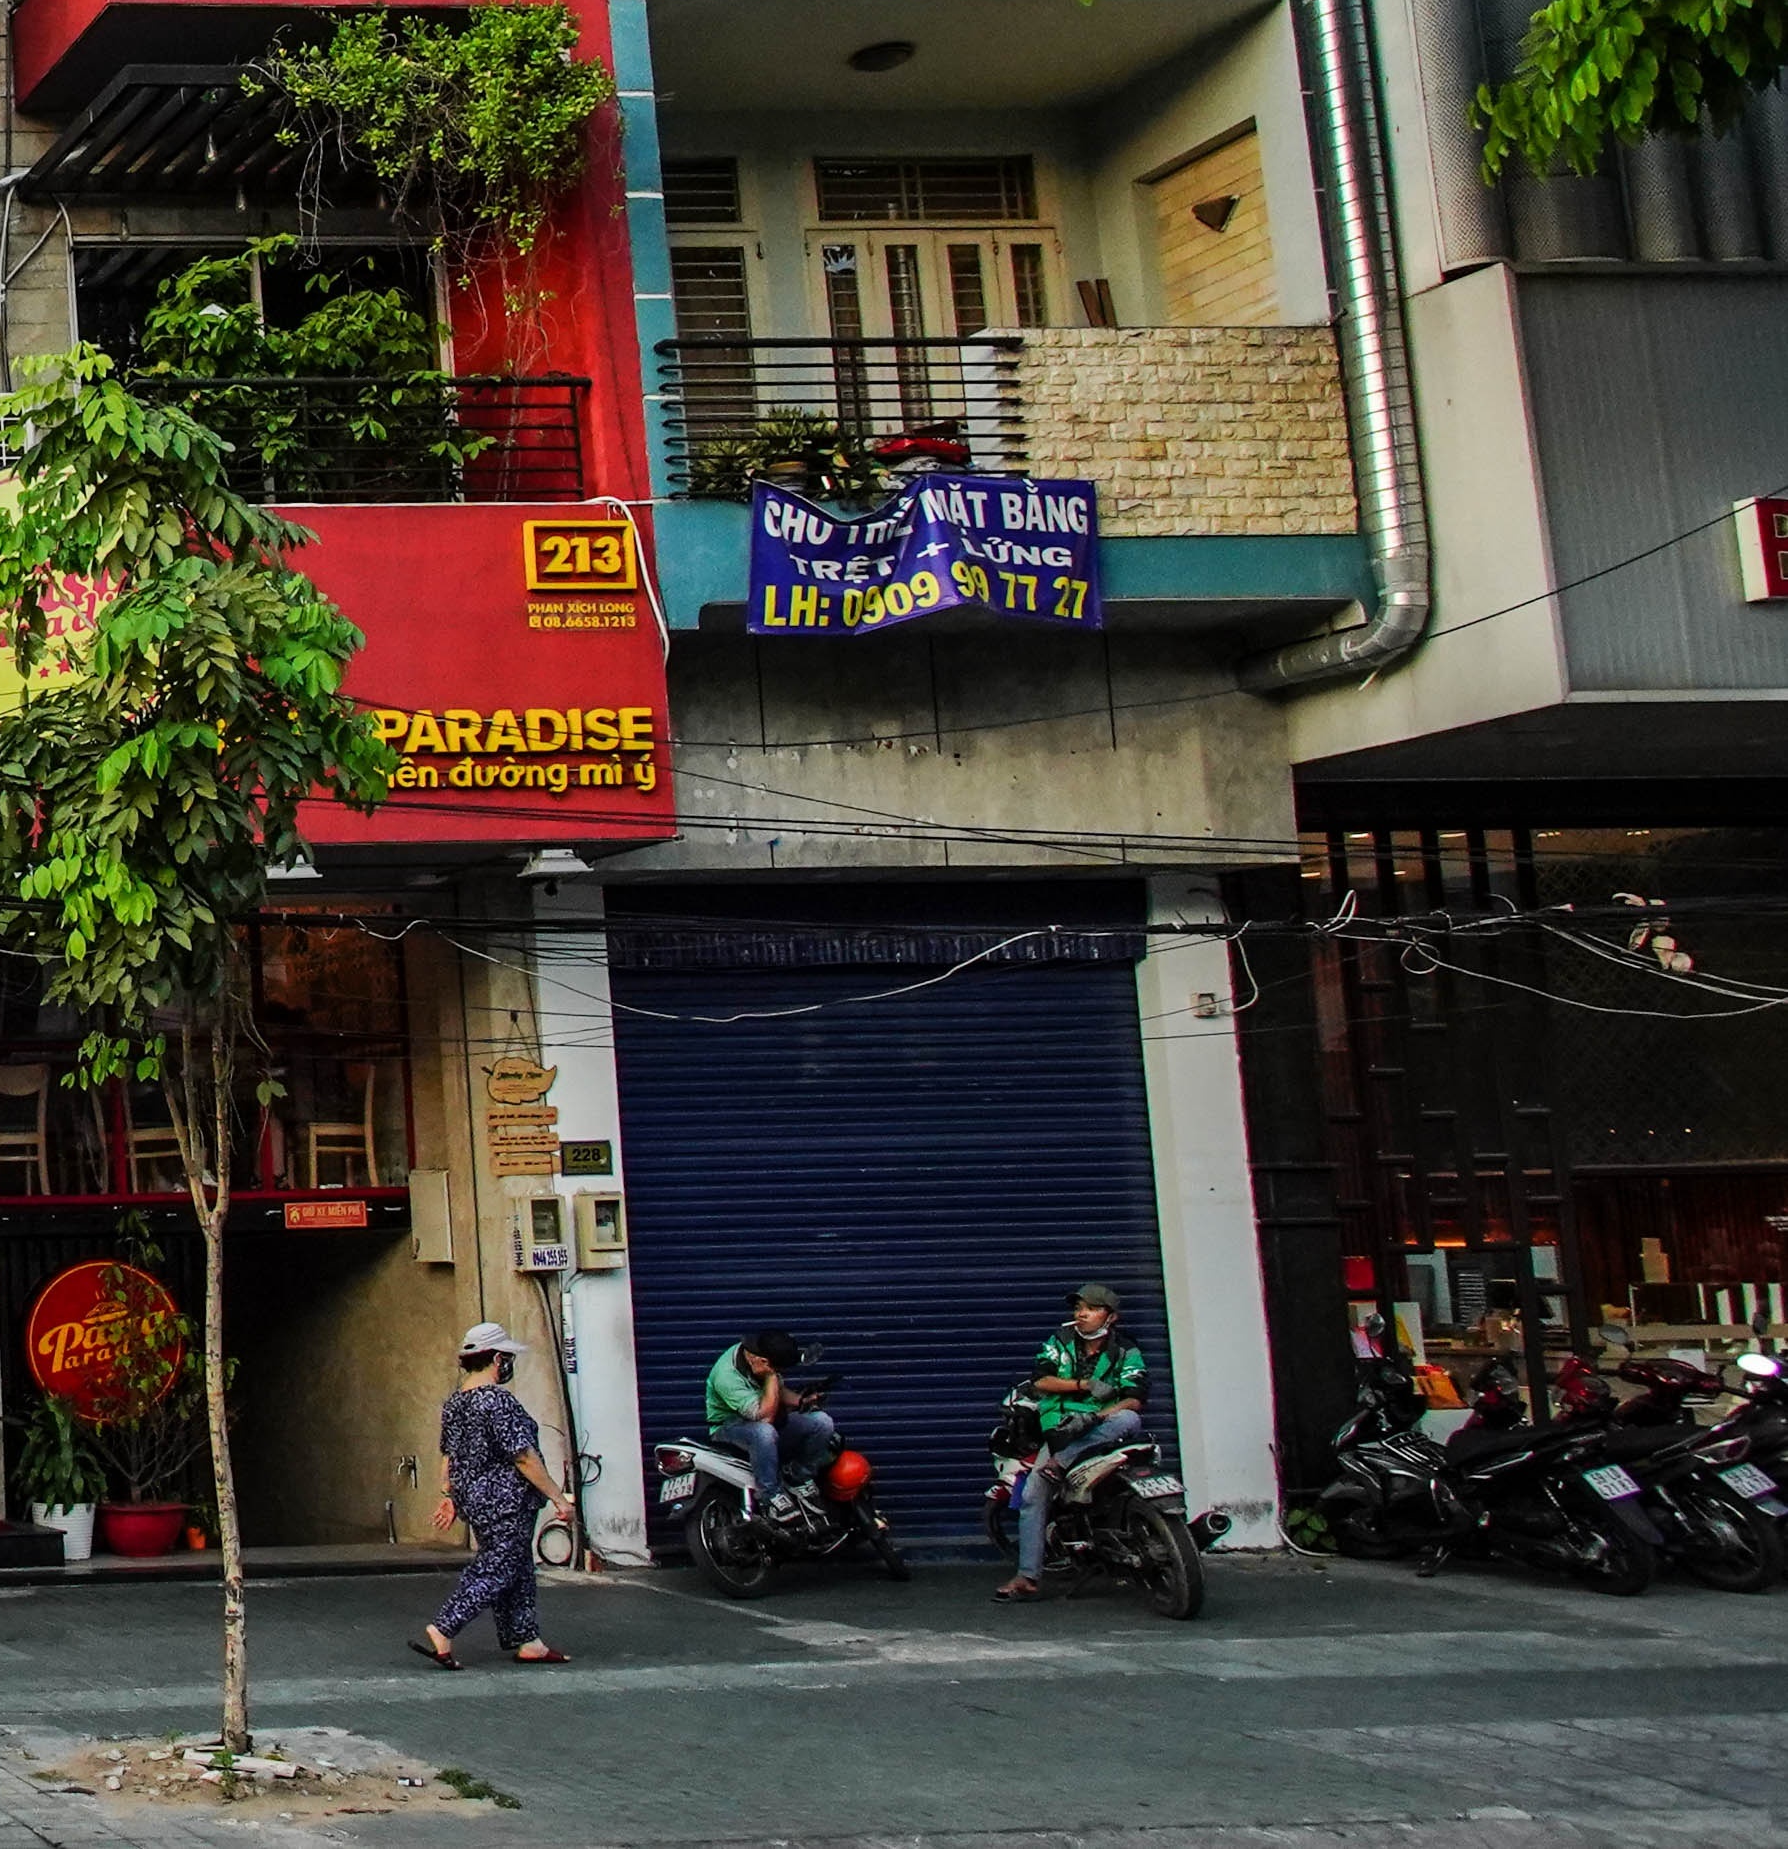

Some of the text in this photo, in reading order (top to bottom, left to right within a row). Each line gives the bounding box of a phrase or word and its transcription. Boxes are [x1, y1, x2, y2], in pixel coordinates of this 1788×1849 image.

[1000, 478, 1088, 534] BẰNG
[541, 536, 622, 574] 213
[790, 555, 895, 583] TRỆT
[528, 602, 564, 613] PHAN
[599, 602, 635, 613] LONG
[764, 560, 1088, 626] LH: 0909 99 77 27
[543, 616, 636, 628] 08.6658.1213
[373, 707, 654, 753] PARADISE
[449, 753, 656, 793] đường mì ý
[573, 1148, 602, 1162] 228
